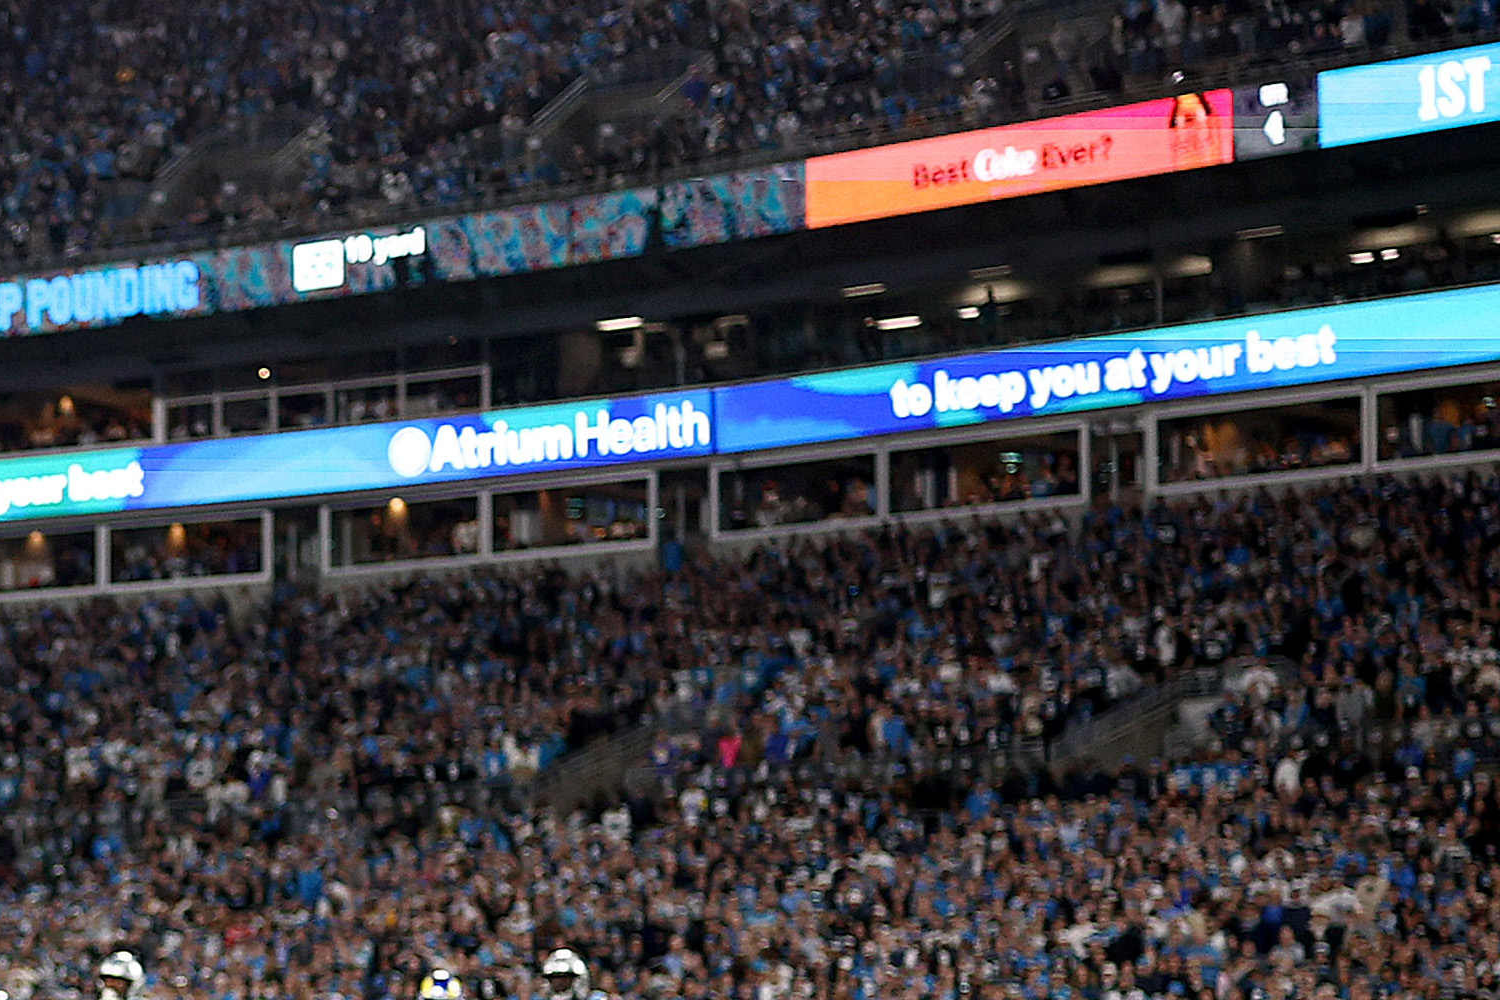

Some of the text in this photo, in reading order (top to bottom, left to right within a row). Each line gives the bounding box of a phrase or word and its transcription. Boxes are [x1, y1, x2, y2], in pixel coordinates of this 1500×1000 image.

[1417, 56, 1492, 121] 1ST
[913, 134, 1114, 190] Best Coke Ever?
[373, 226, 426, 266] yard
[26, 260, 199, 330] POUNDING
[889, 325, 1336, 418] to keep you at your best
[429, 400, 711, 473] Atrium Health
[68, 461, 144, 501] best
